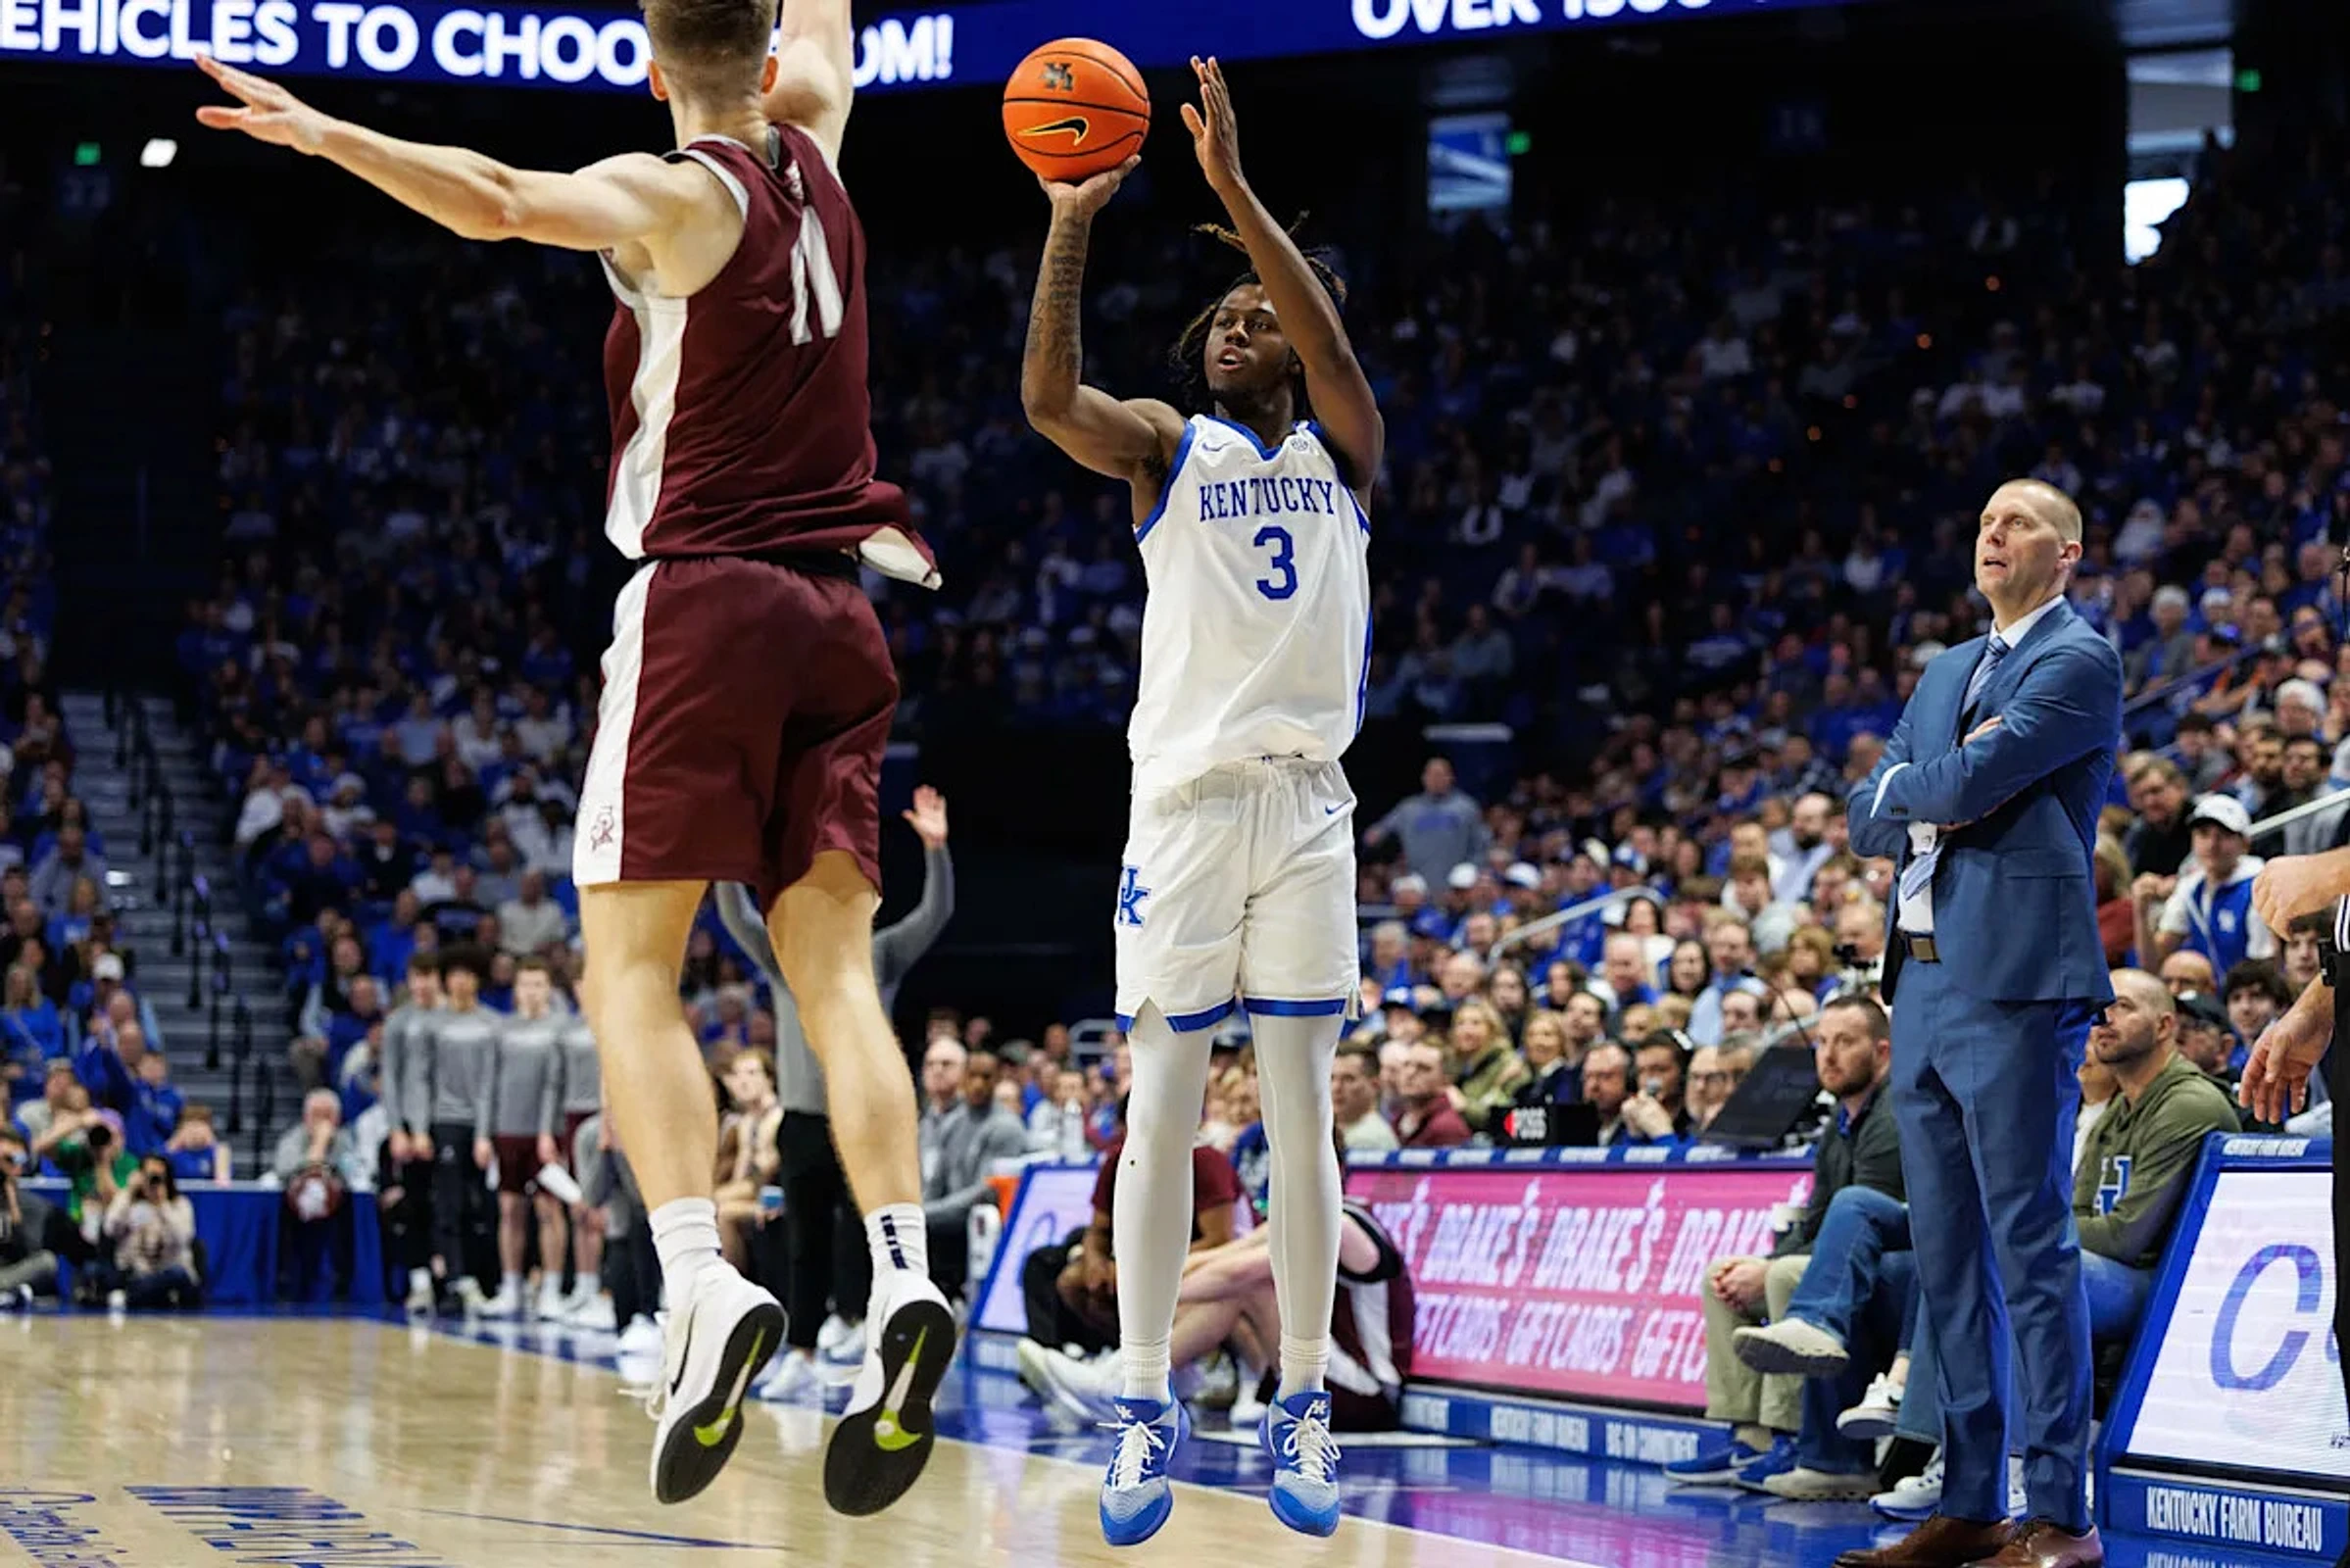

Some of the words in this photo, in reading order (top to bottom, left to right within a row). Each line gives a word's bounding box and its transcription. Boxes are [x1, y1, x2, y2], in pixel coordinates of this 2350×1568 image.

[0, 0, 299, 66] EHICLES
[313, 3, 419, 73] TO
[432, 9, 651, 86] CHOO
[789, 204, 844, 346] 11
[1199, 476, 1335, 522] KENTUCKY
[1253, 526, 1298, 600] 3
[1532, 1179, 1665, 1294] DRAKE'S
[2211, 1245, 2339, 1392] C
[2146, 1486, 2219, 1537] KENTUCKY
[2220, 1495, 2261, 1544] FARM
[2264, 1501, 2323, 1552] BUREAU
